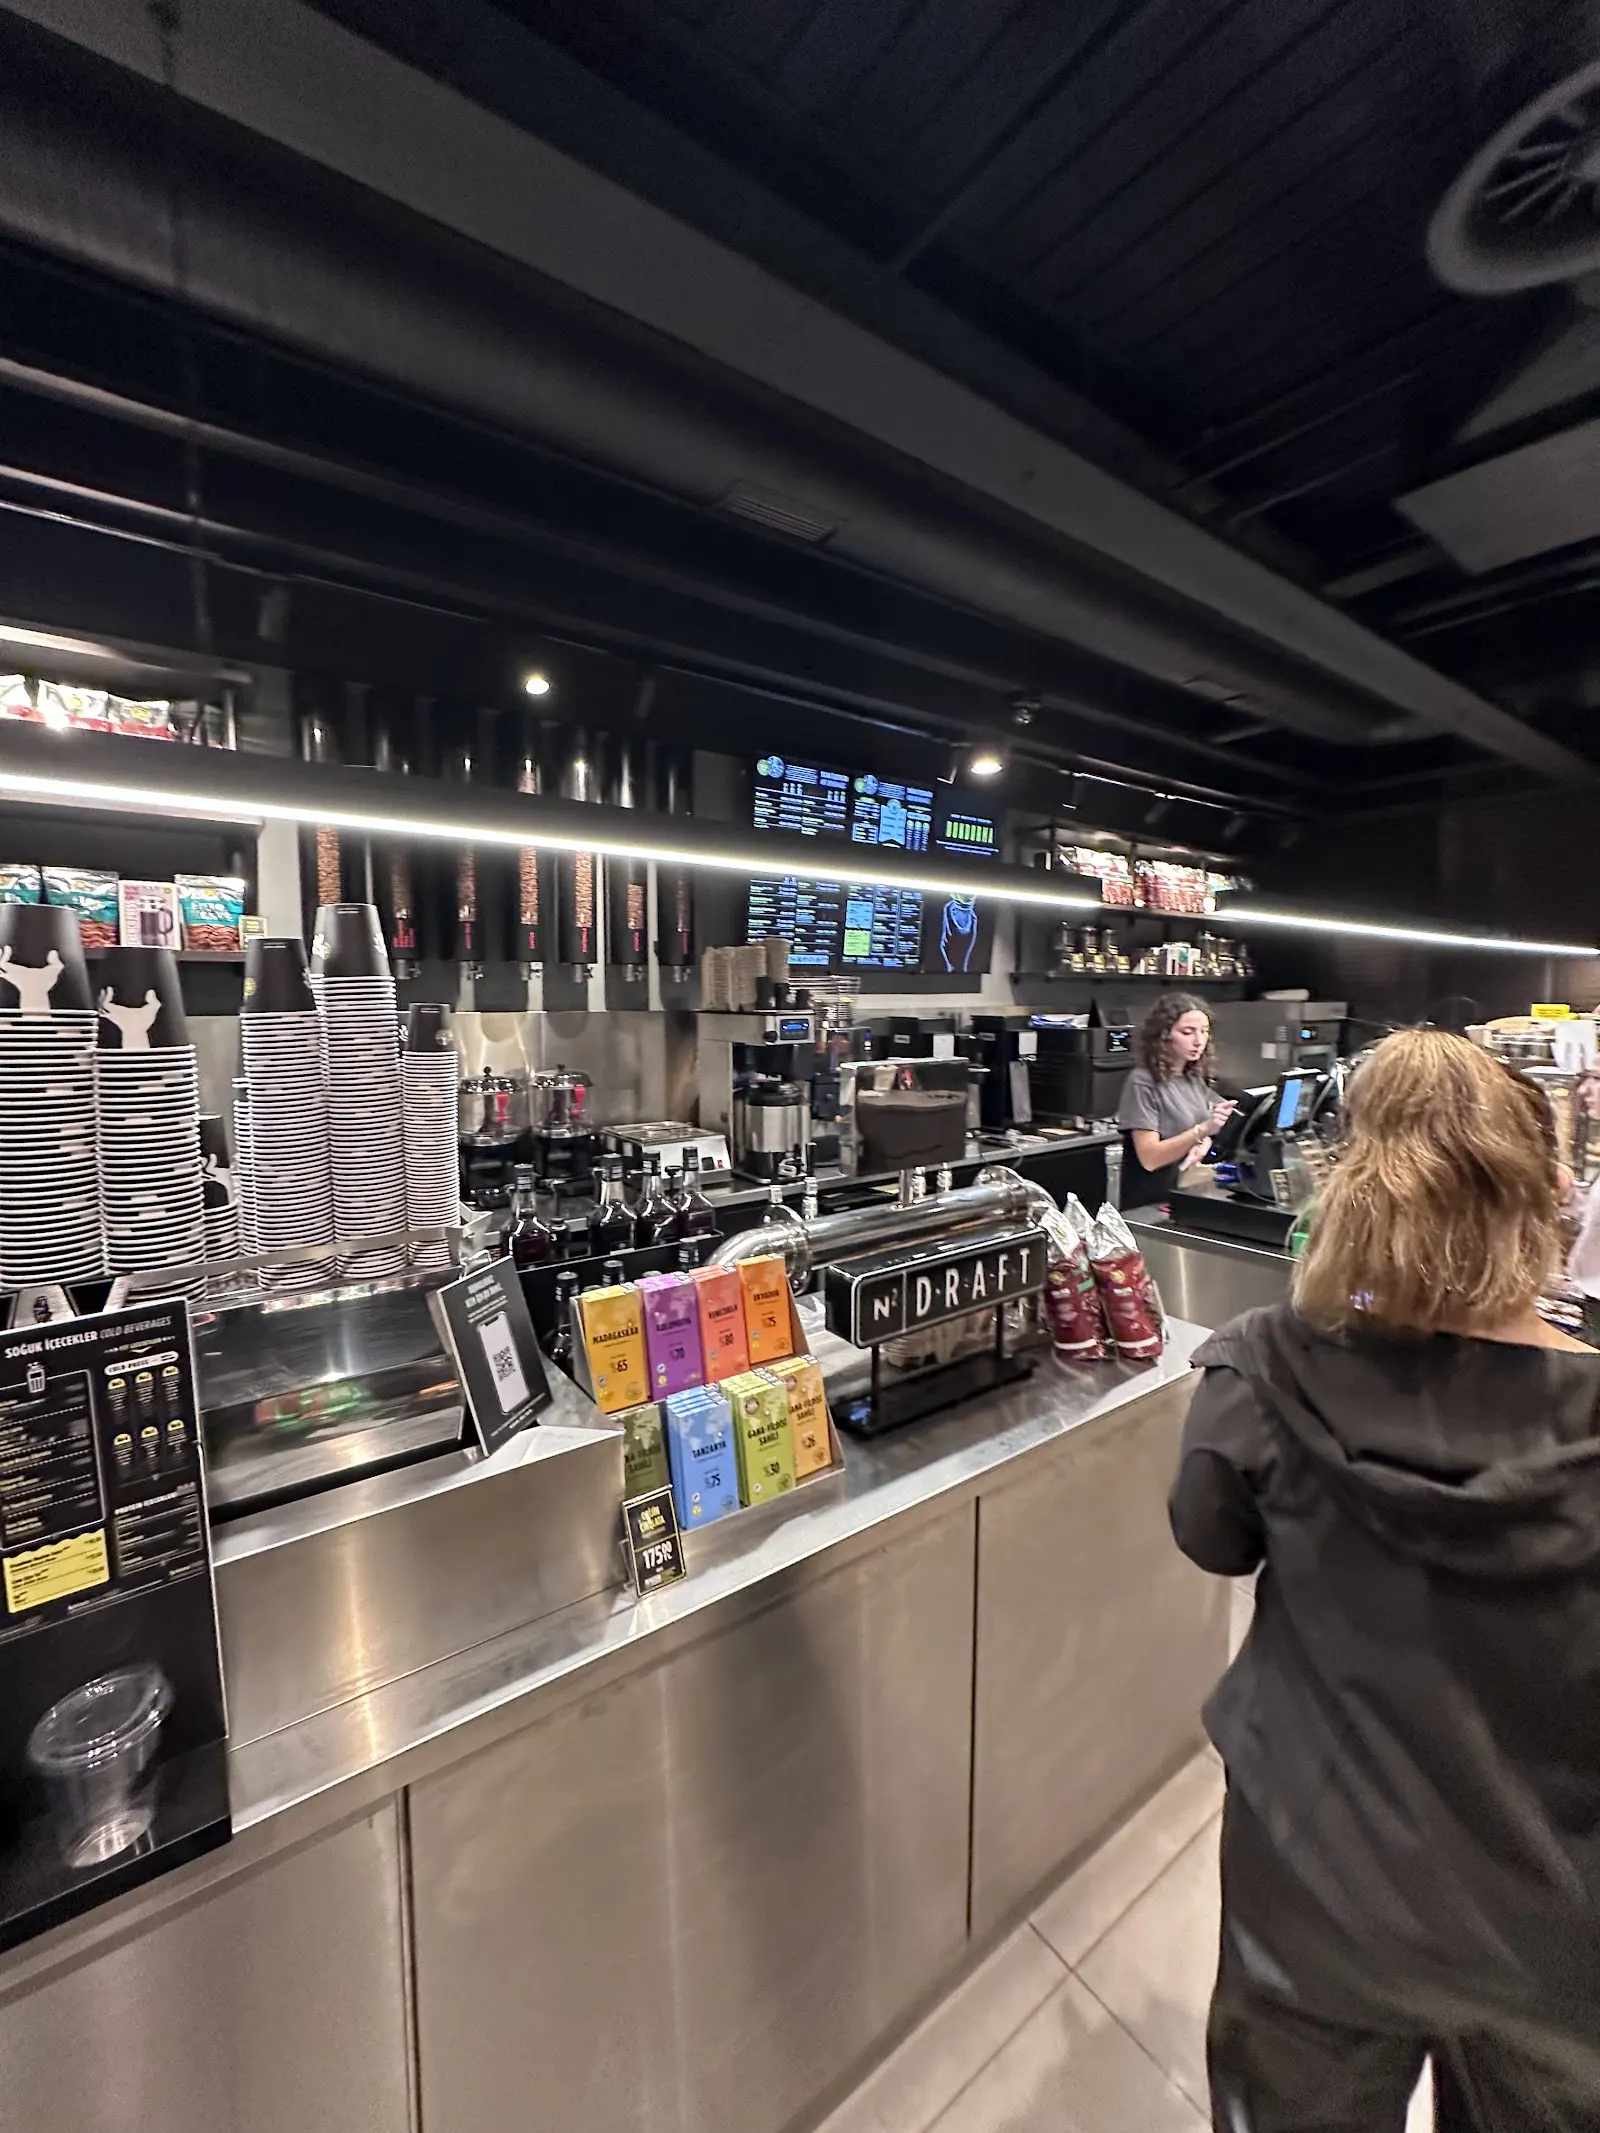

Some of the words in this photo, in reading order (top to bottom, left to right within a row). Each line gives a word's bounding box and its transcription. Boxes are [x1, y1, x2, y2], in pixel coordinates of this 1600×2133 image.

[592, 1326, 640, 1345] MADAGASKAR
[4, 1341, 43, 1359] SOĞUK
[692, 1440, 727, 1458] TANZANYA
